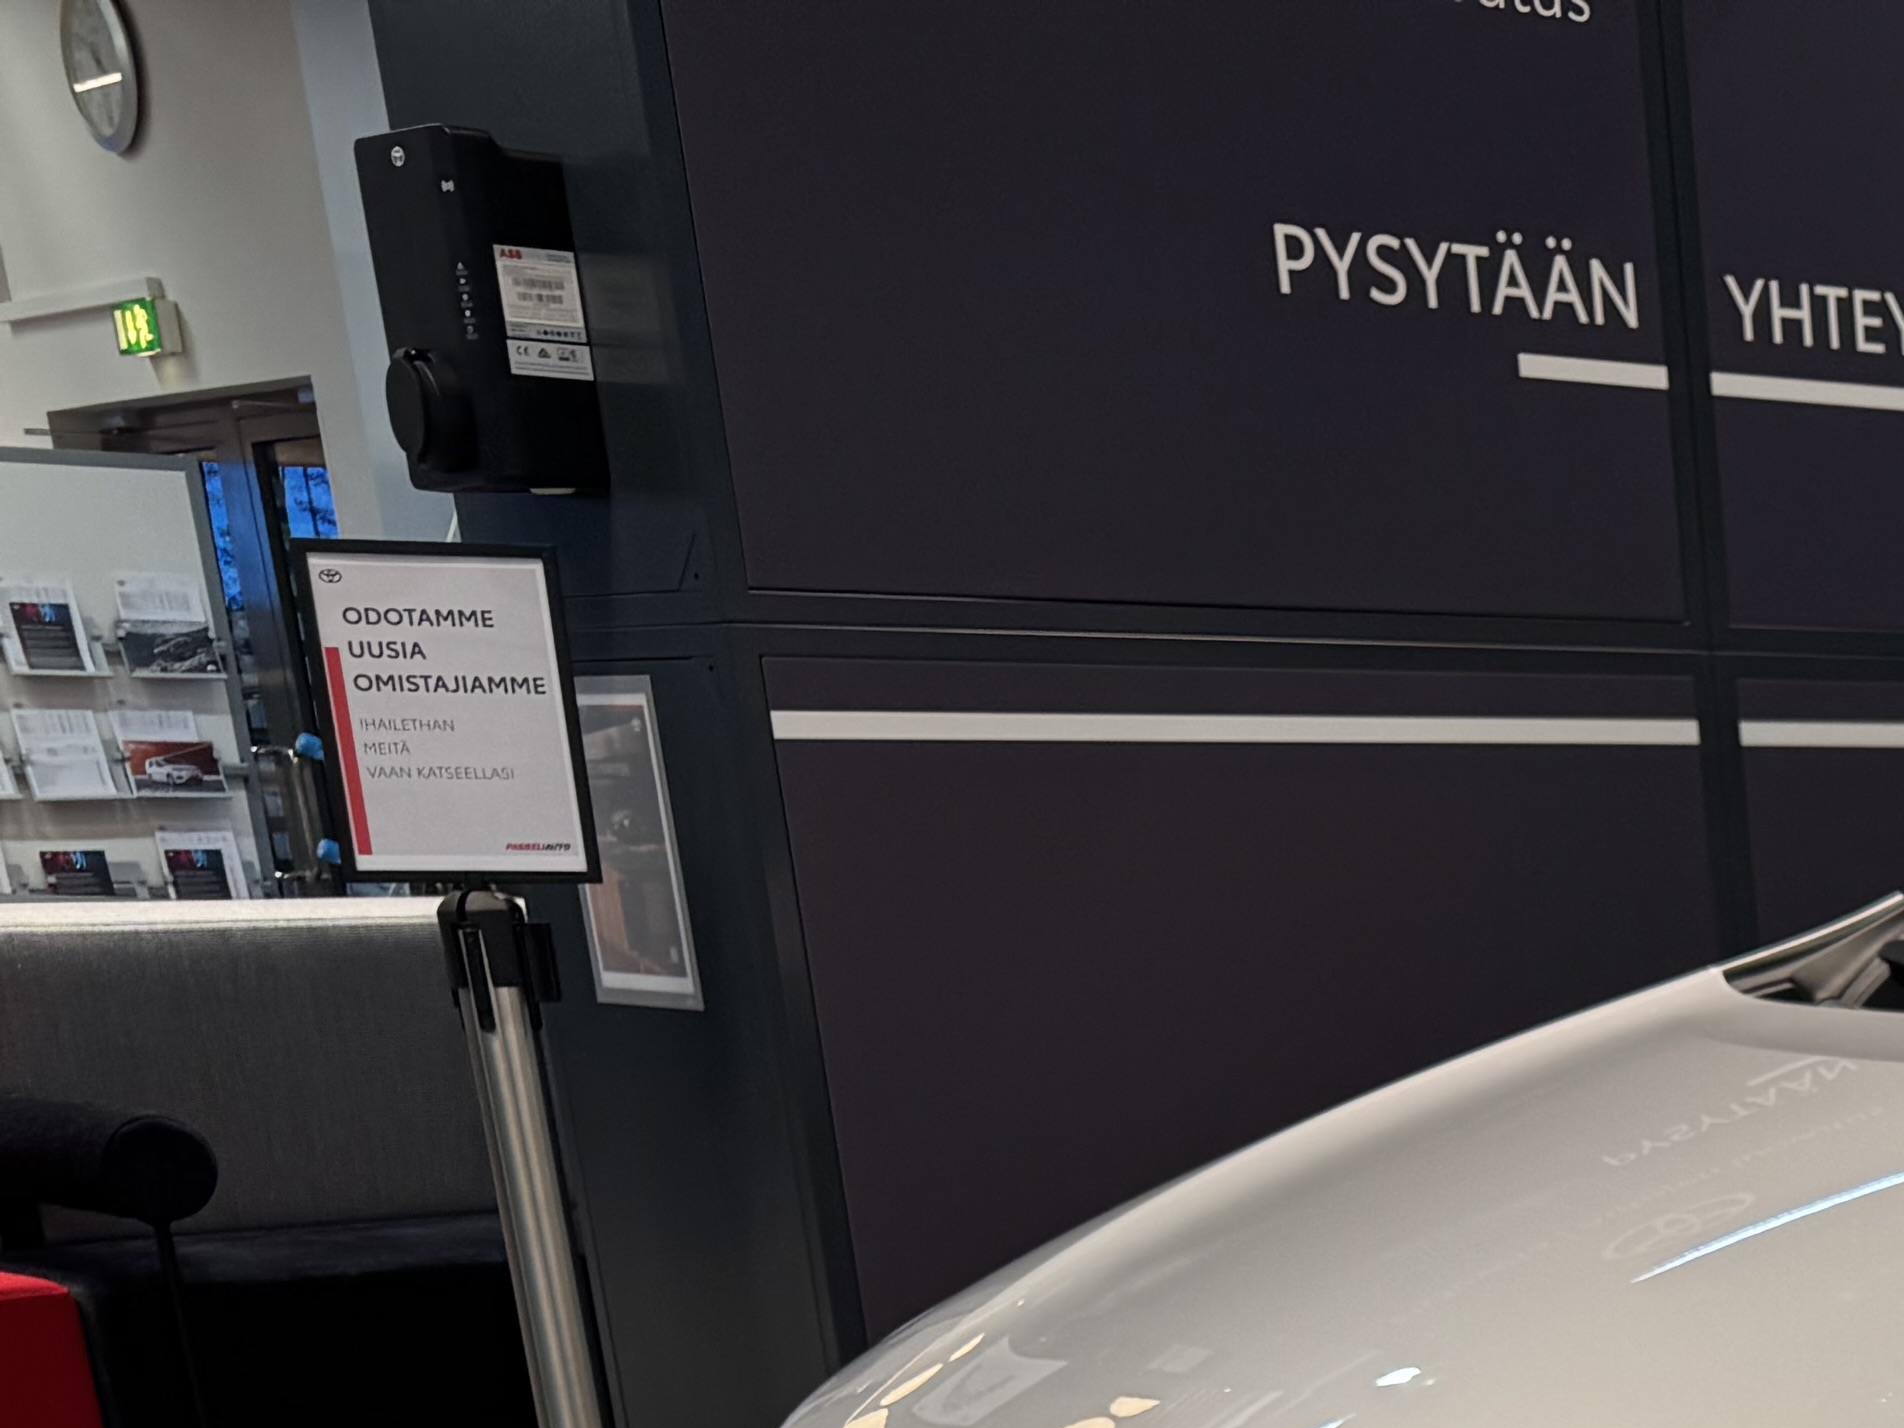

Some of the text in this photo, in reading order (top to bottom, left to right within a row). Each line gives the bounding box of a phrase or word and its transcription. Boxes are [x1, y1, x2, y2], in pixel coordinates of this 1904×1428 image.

[1273, 222, 1639, 329] PYSYTÄÄN
[342, 606, 495, 628] ODOTAMME
[347, 640, 427, 660] UUSIA
[353, 674, 547, 695] OMISTAJIAMME
[360, 718, 455, 732] IHAILETHAN
[364, 740, 411, 755] MEITÄ
[368, 766, 412, 779] VAAN
